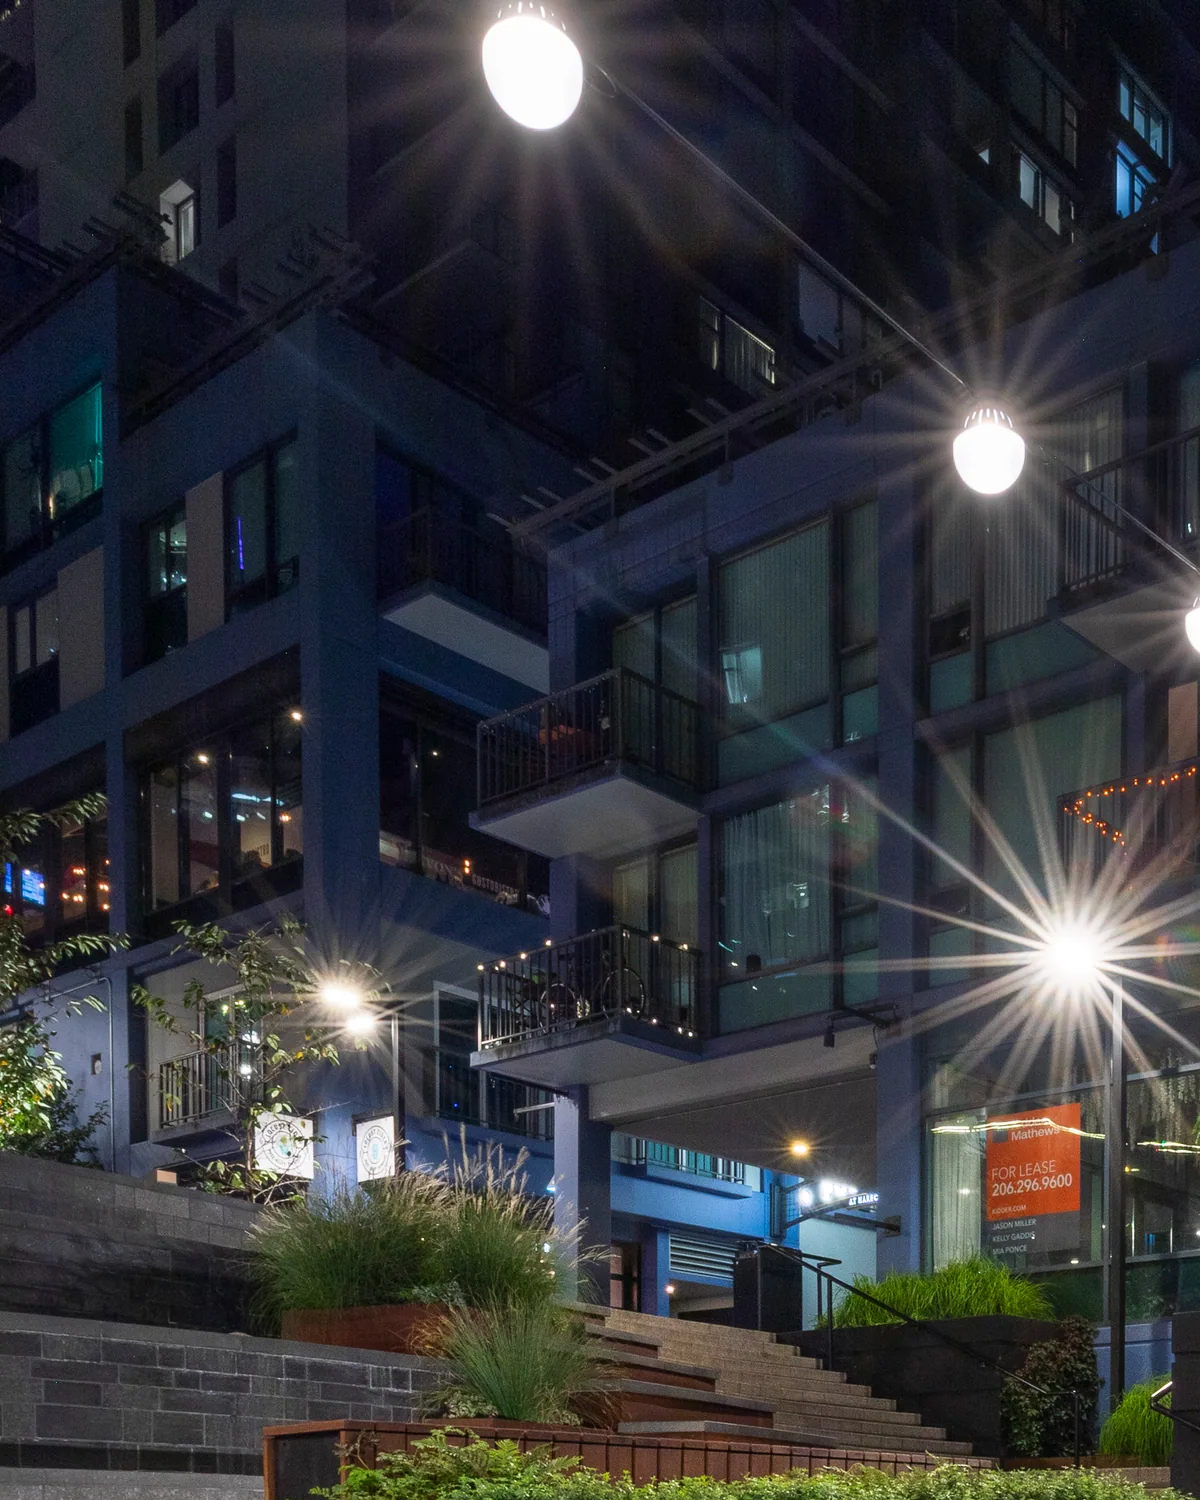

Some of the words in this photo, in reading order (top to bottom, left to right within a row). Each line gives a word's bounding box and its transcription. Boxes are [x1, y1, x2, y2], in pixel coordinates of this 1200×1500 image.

[1011, 1127, 1060, 1141] Mathews
[991, 1165, 1016, 1181] FOR
[1019, 1159, 1056, 1178] LEASE
[991, 1173, 1073, 1197] 206.296.9600
[991, 1204, 1027, 1214] KIDDER.COM
[992, 1221, 1014, 1230] JASON
[1014, 1219, 1037, 1227] MILLER
[992, 1234, 1010, 1242] KELLY
[1005, 1244, 1027, 1253] PONCE
